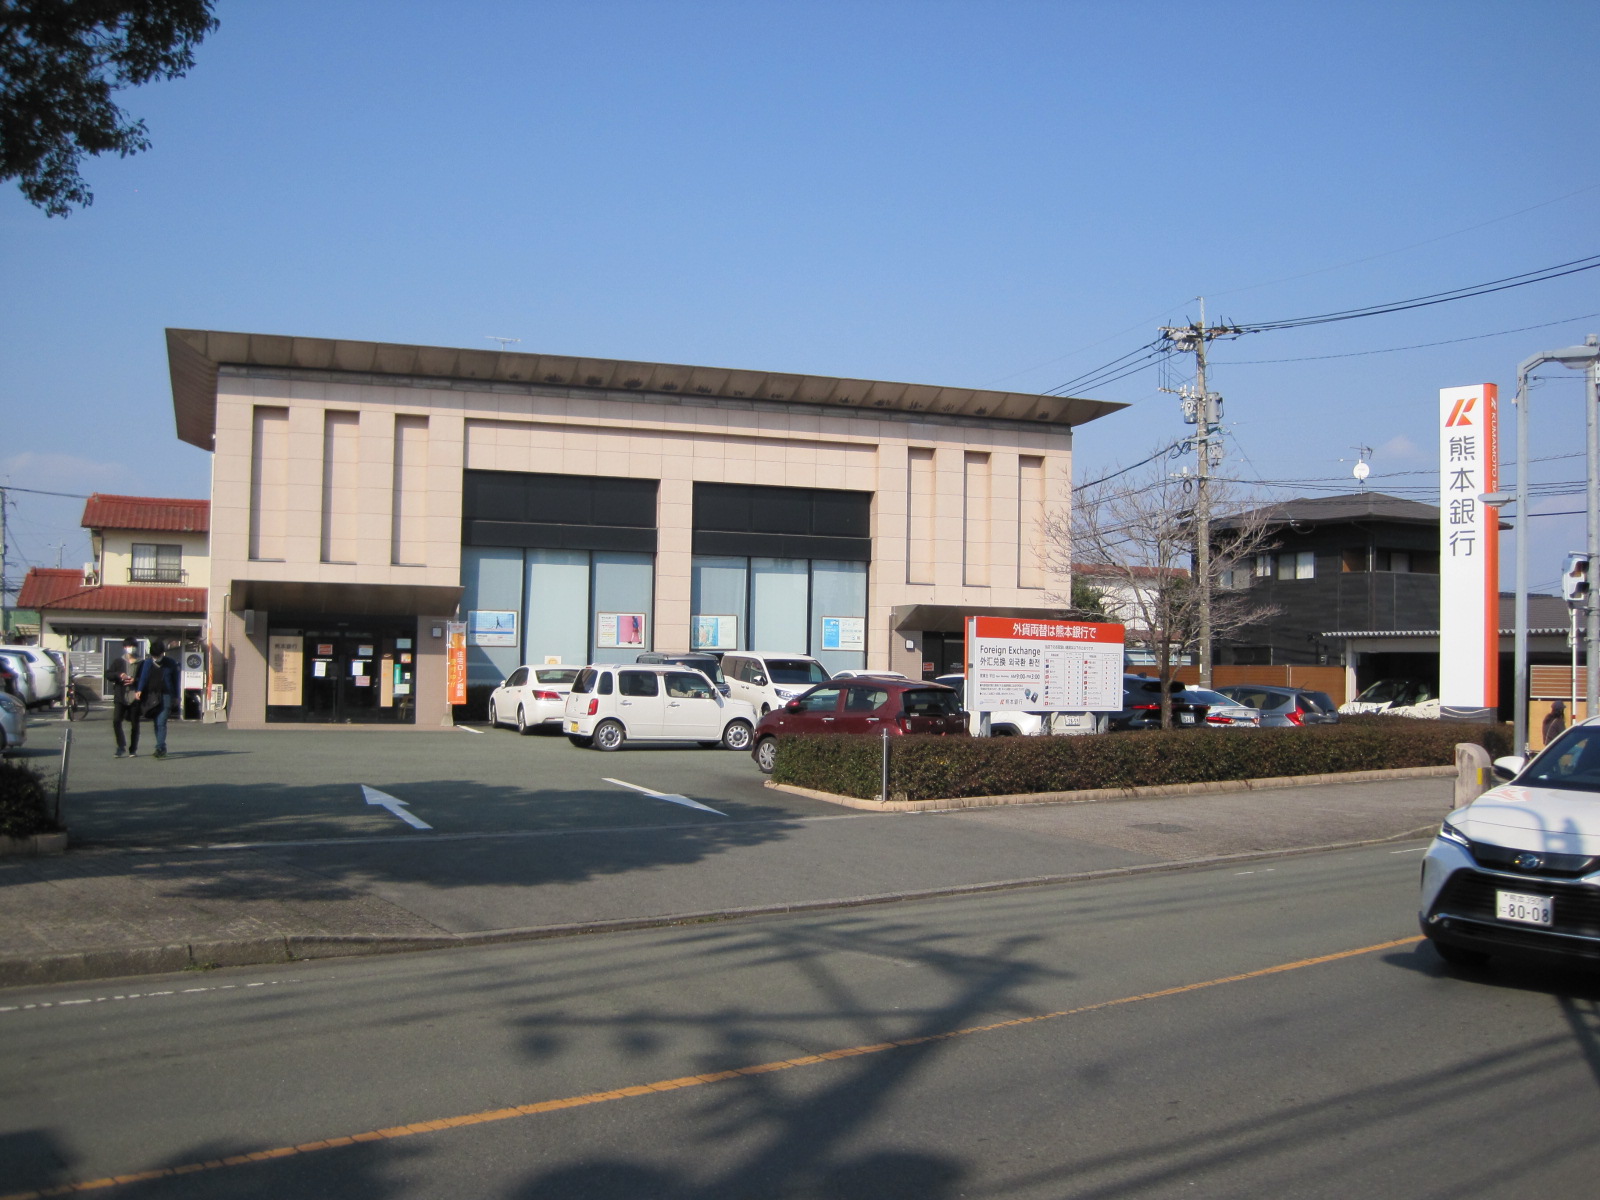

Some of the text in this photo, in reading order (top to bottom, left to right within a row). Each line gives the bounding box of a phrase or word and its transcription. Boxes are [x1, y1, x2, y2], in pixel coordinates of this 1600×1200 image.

[1449, 435, 1475, 557] 熊本銀行
[1013, 623, 1097, 639] 外貨両替は熊本銀行で
[980, 645, 1007, 656] Foreign
[1008, 646, 1041, 658] Exchange
[1508, 904, 1549, 922] 80-08
